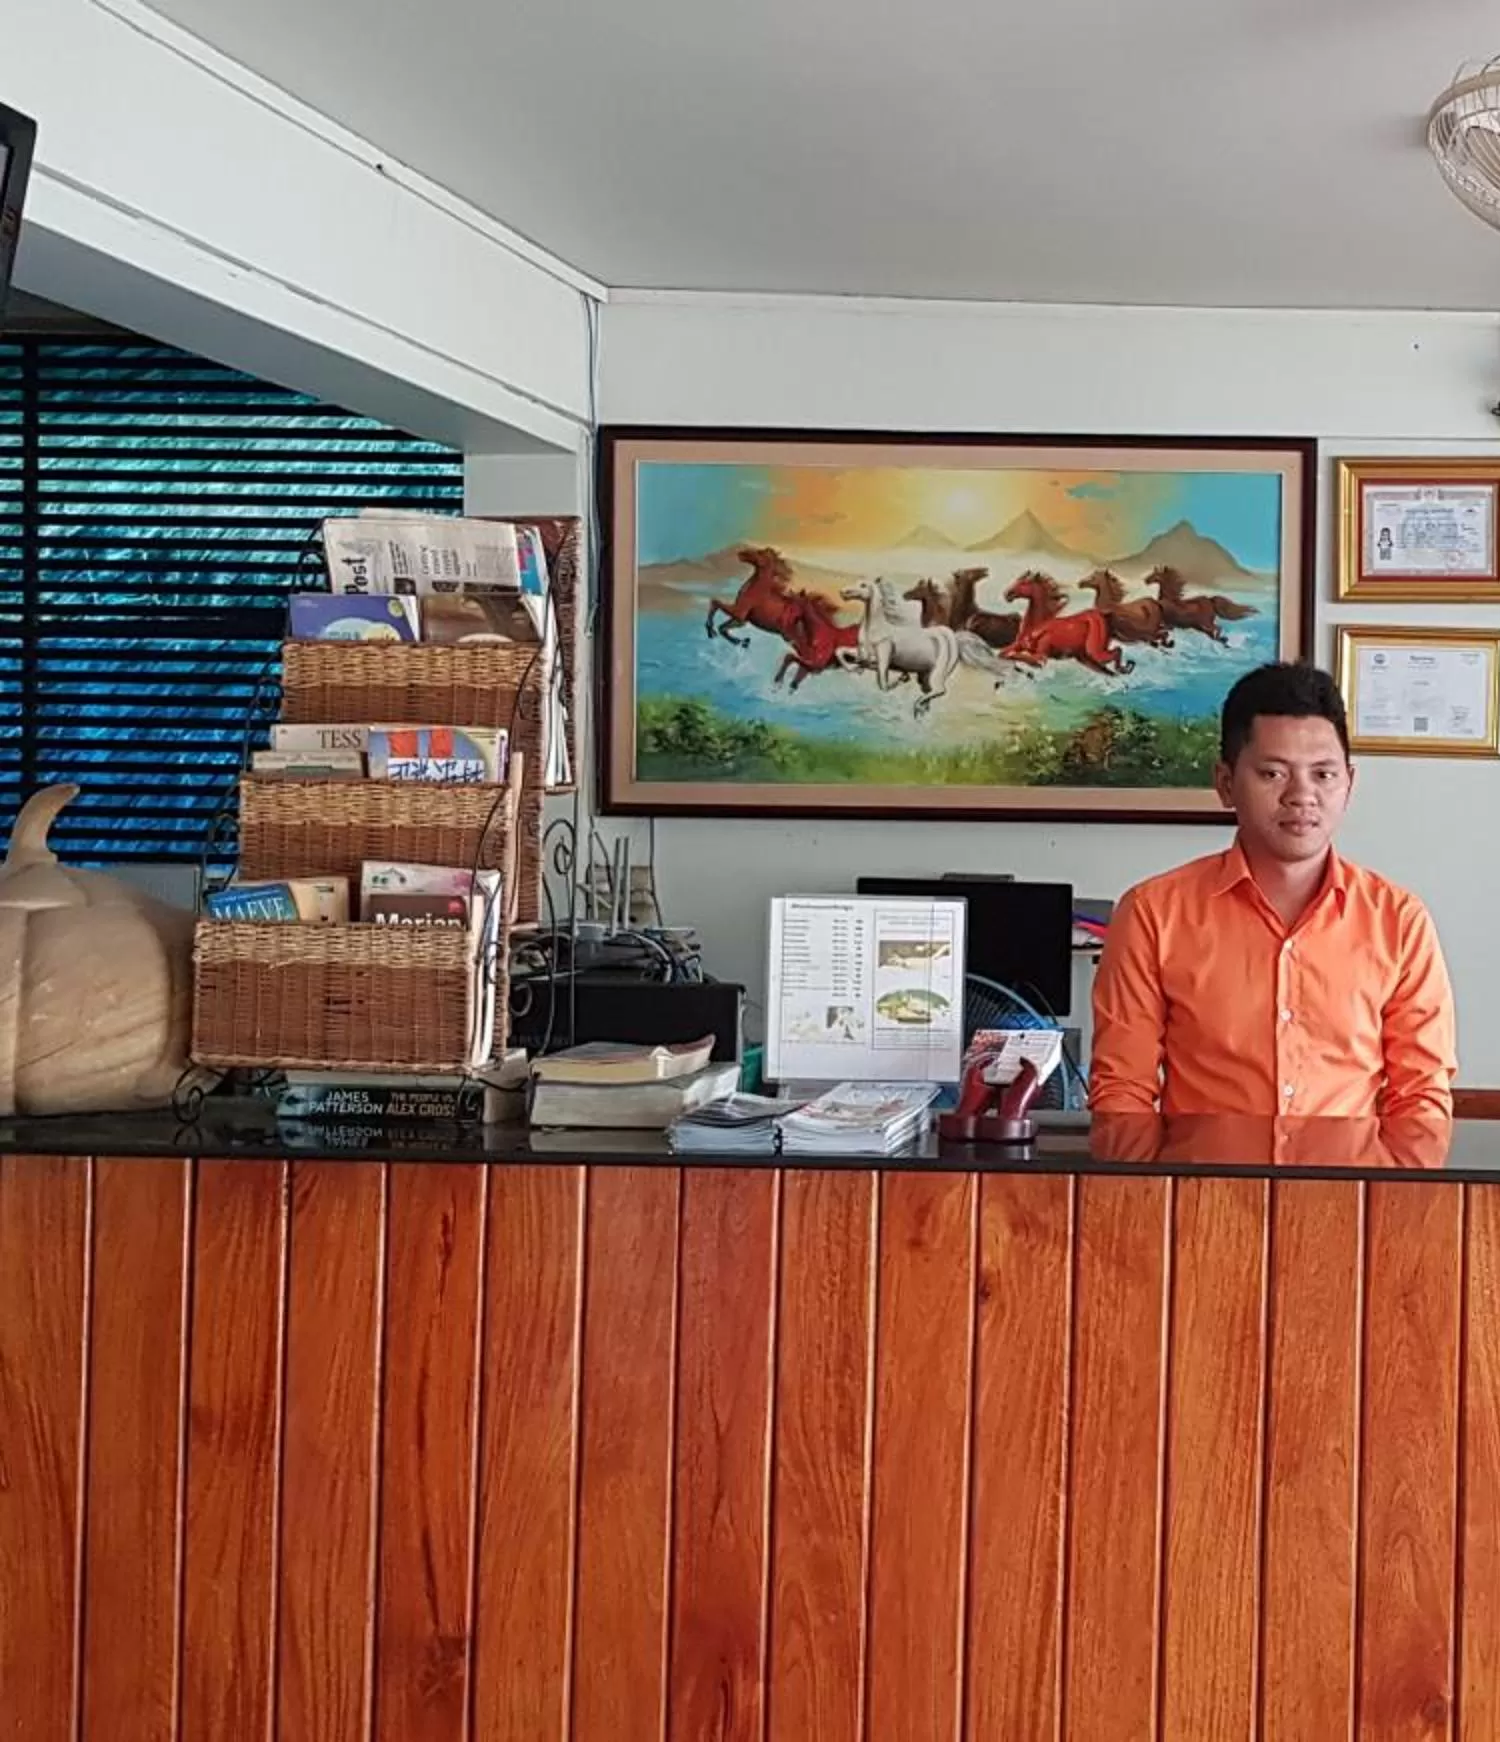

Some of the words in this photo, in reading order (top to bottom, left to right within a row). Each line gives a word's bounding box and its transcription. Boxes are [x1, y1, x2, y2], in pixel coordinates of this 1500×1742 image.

[342, 557, 369, 595] Post
[317, 729, 362, 749] TESS
[326, 1091, 369, 1103] JAMES
[309, 1102, 384, 1116] PATTERSON
[386, 1103, 417, 1116] ALEX
